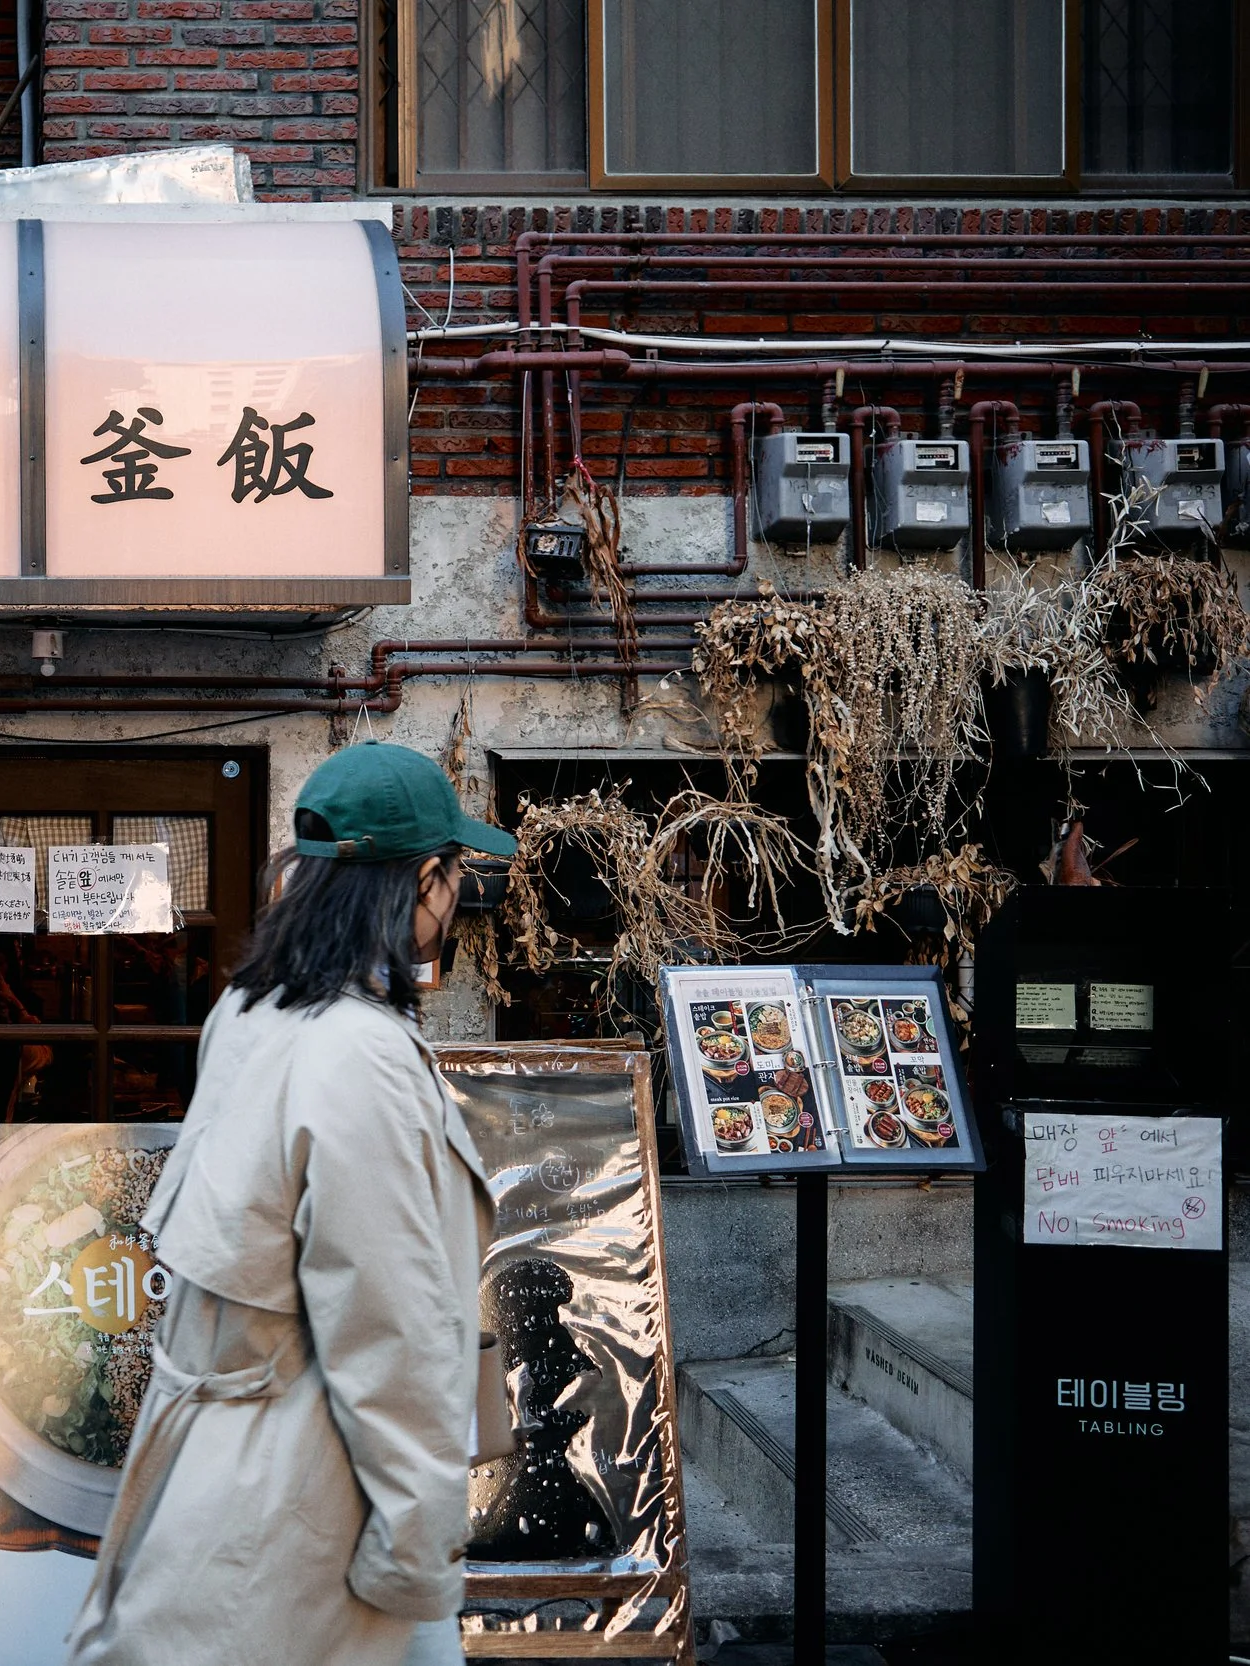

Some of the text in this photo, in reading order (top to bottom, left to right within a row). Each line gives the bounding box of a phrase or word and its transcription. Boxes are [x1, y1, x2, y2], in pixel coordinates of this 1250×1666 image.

[80, 406, 334, 504] 釜飯
[1032, 1123, 1178, 1154] 매장 앞 에서
[1036, 1167, 1080, 1192] 담배
[865, 1346, 894, 1376] WASHED
[1057, 1378, 1185, 1412] 테이블링
[1078, 1419, 1164, 1436] TABLING
